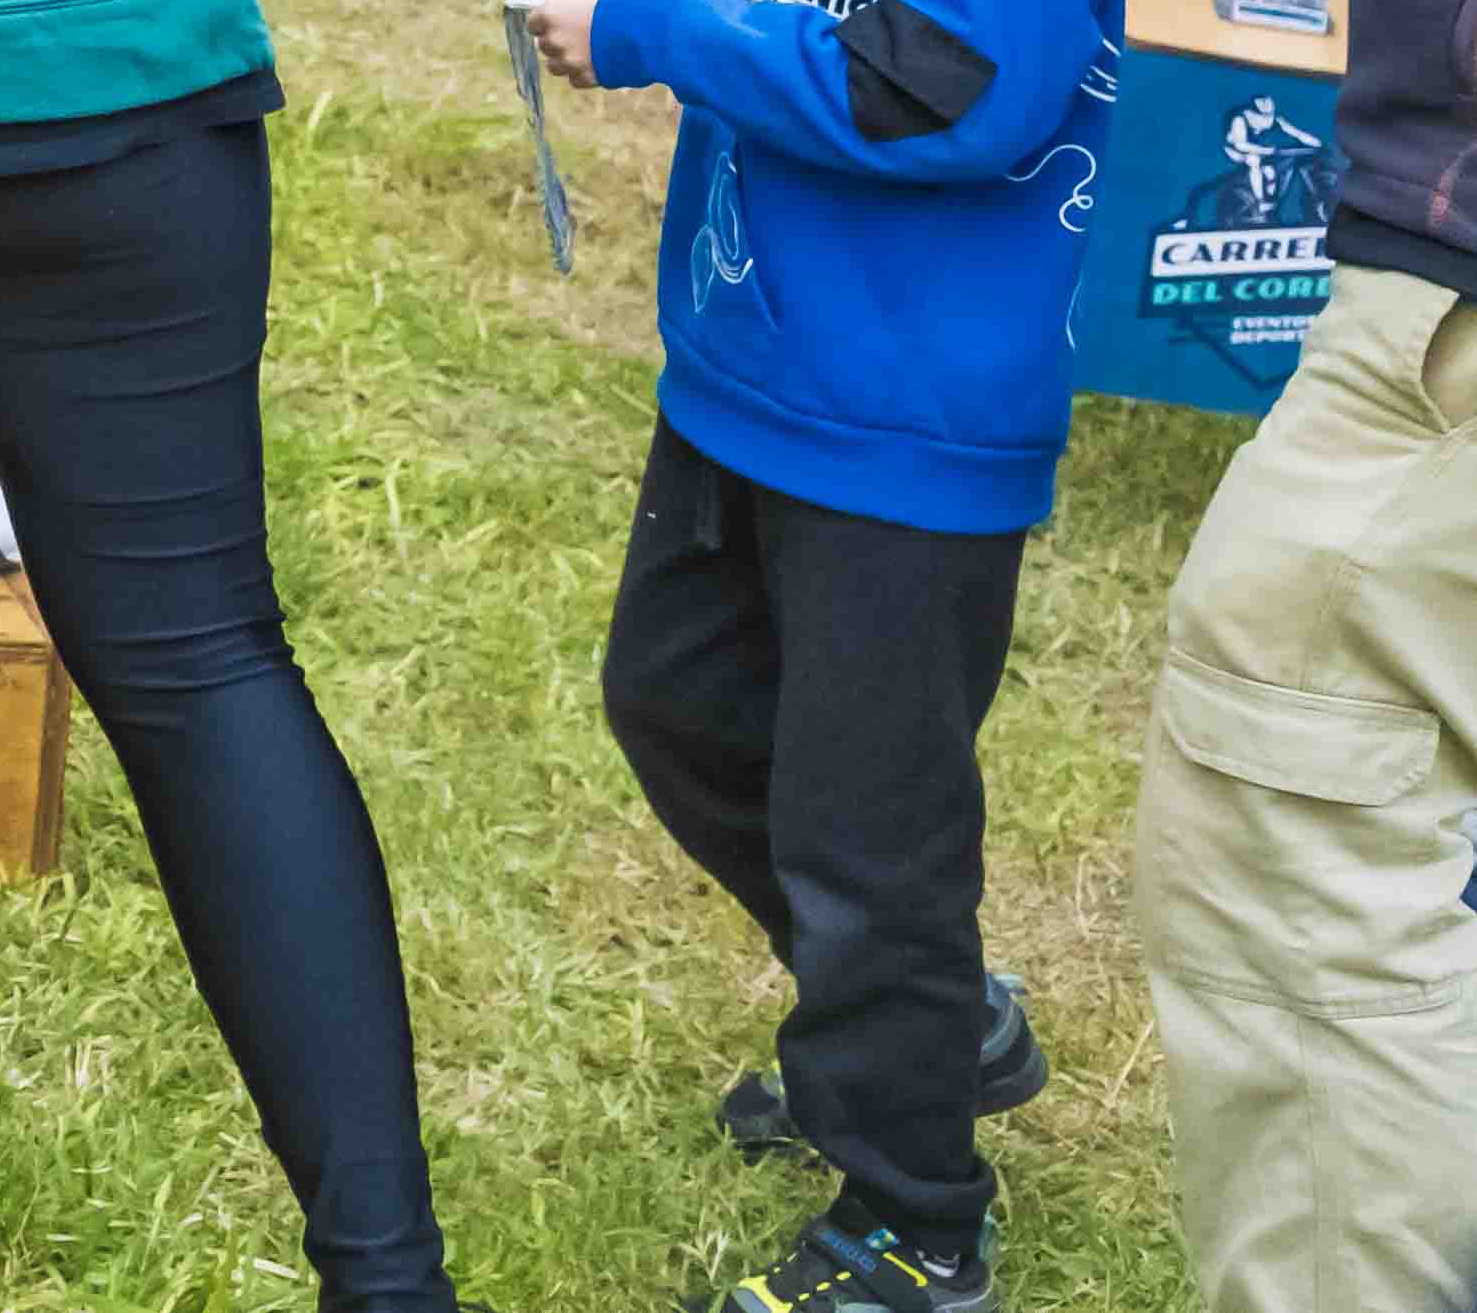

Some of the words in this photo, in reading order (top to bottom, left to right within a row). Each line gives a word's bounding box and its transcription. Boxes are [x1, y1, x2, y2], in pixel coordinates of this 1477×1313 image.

[1160, 237, 1329, 266] CARRE
[1152, 280, 1220, 306] DEL
[1232, 275, 1330, 301] COR
